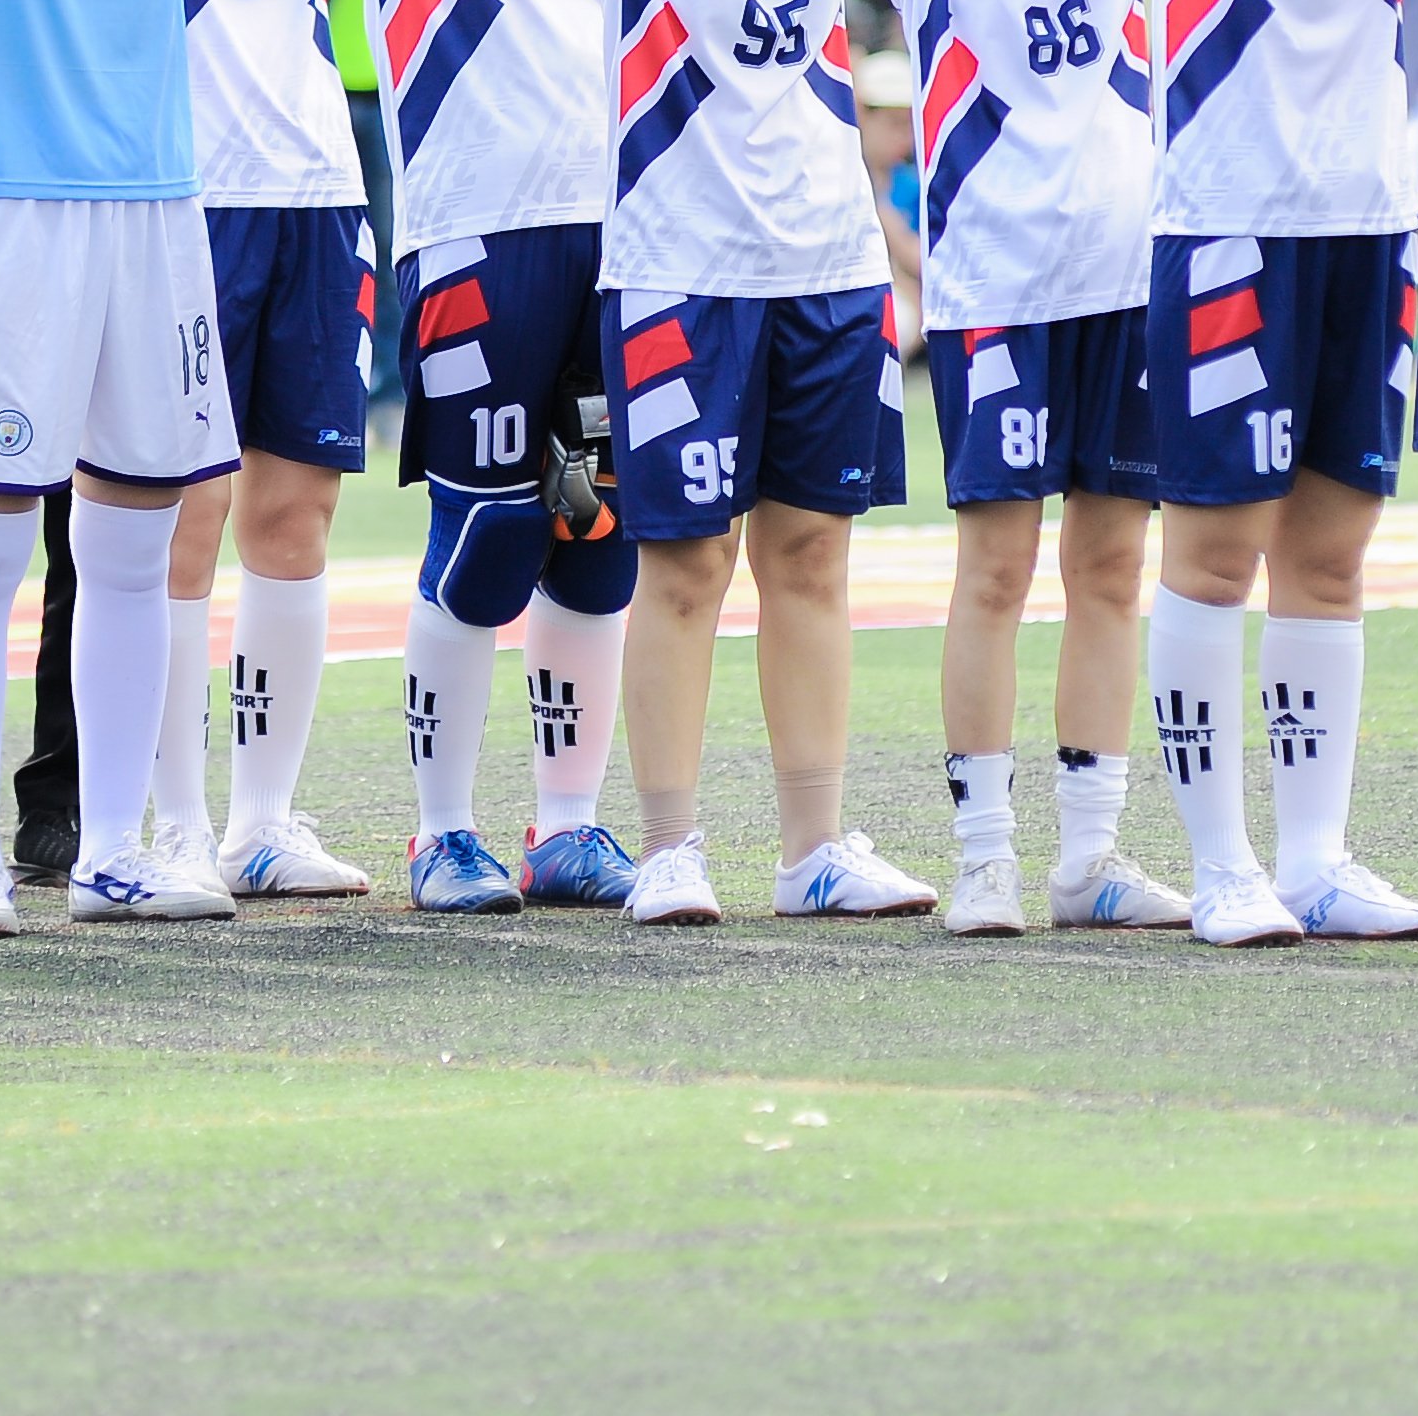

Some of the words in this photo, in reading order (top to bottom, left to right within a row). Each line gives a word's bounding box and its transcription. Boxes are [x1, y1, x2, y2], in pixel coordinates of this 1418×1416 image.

[179, 314, 211, 395] 18
[470, 403, 527, 468] 10
[1248, 408, 1293, 474] 16
[681, 436, 739, 505] 95
[231, 693, 274, 709] ORT
[405, 711, 441, 732] ORT
[530, 703, 583, 720] PORT
